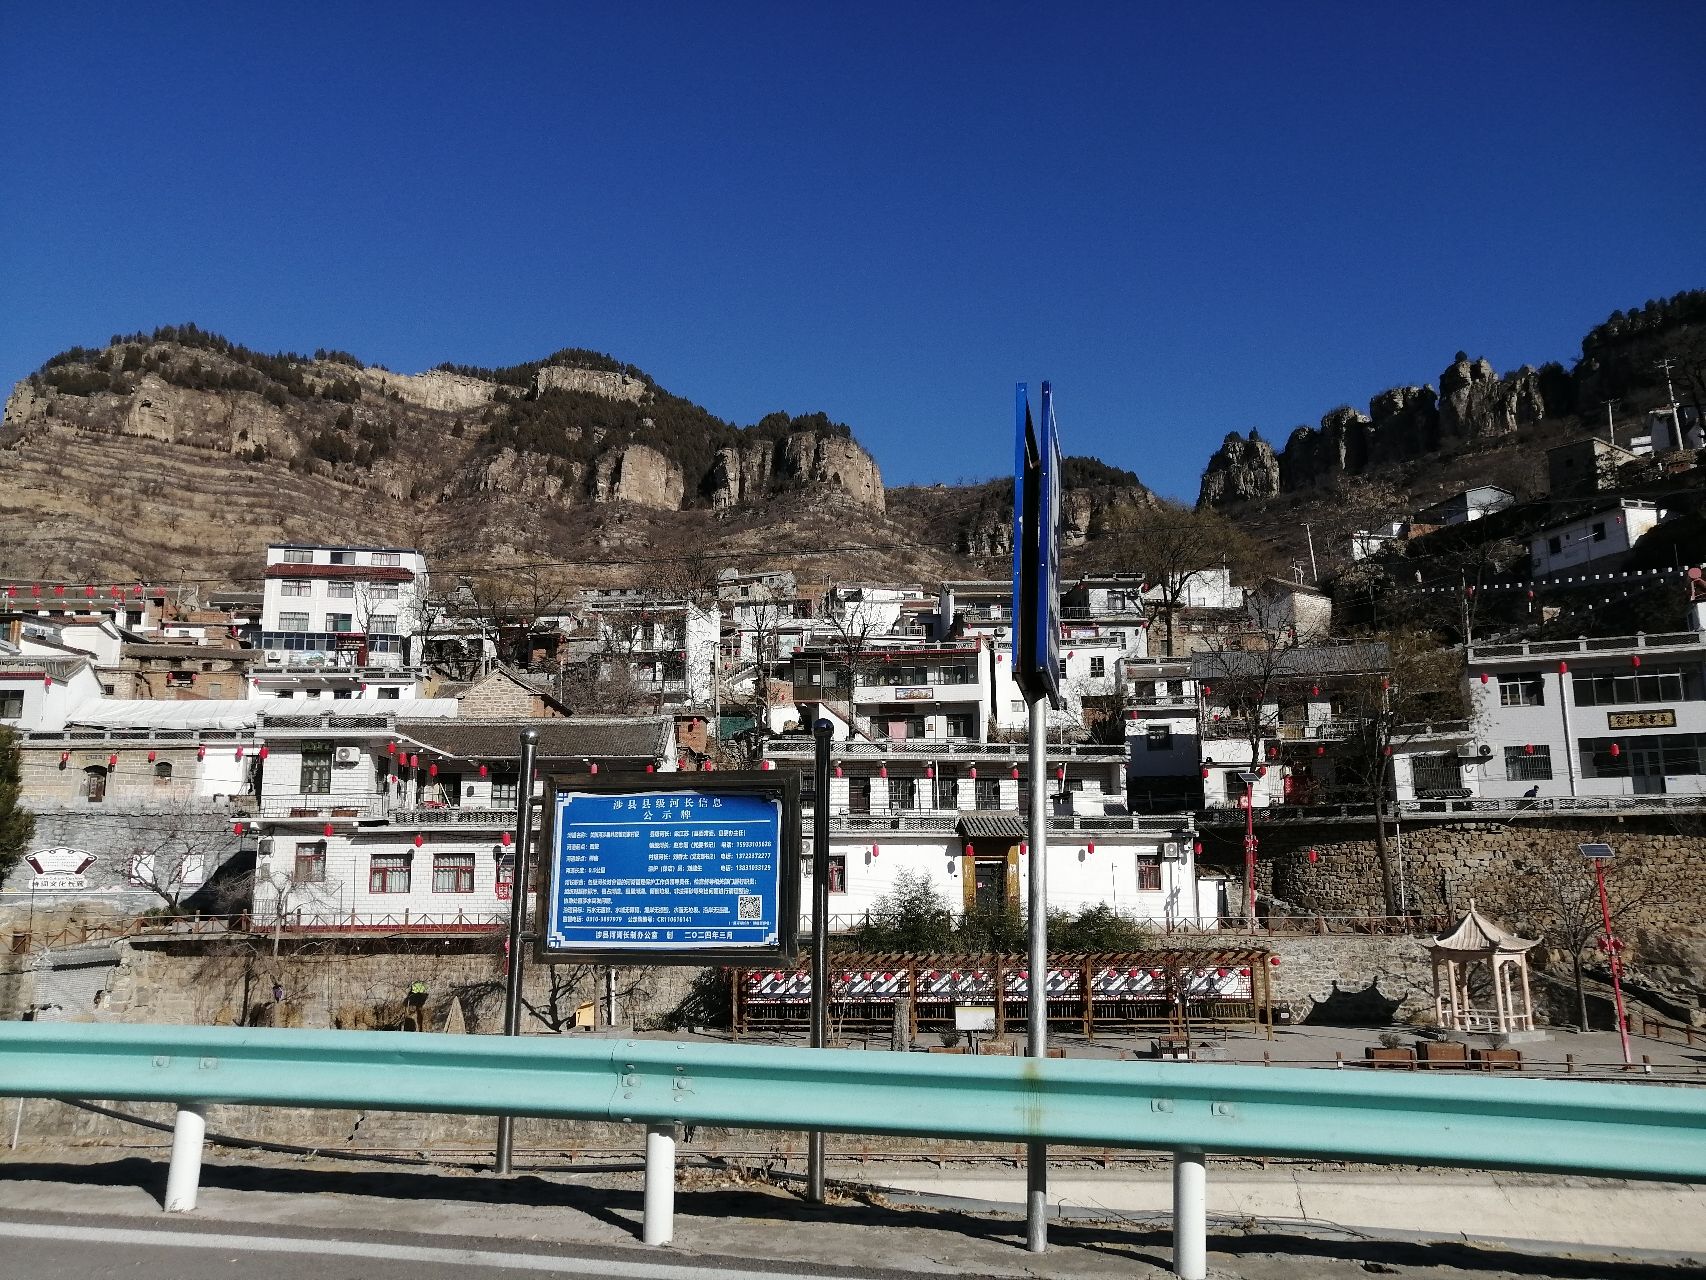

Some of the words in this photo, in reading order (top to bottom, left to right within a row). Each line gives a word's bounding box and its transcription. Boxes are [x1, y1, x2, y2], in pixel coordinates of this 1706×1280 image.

[613, 798, 723, 810] 涉县县级河长信息
[643, 810, 692, 821] 公示牌
